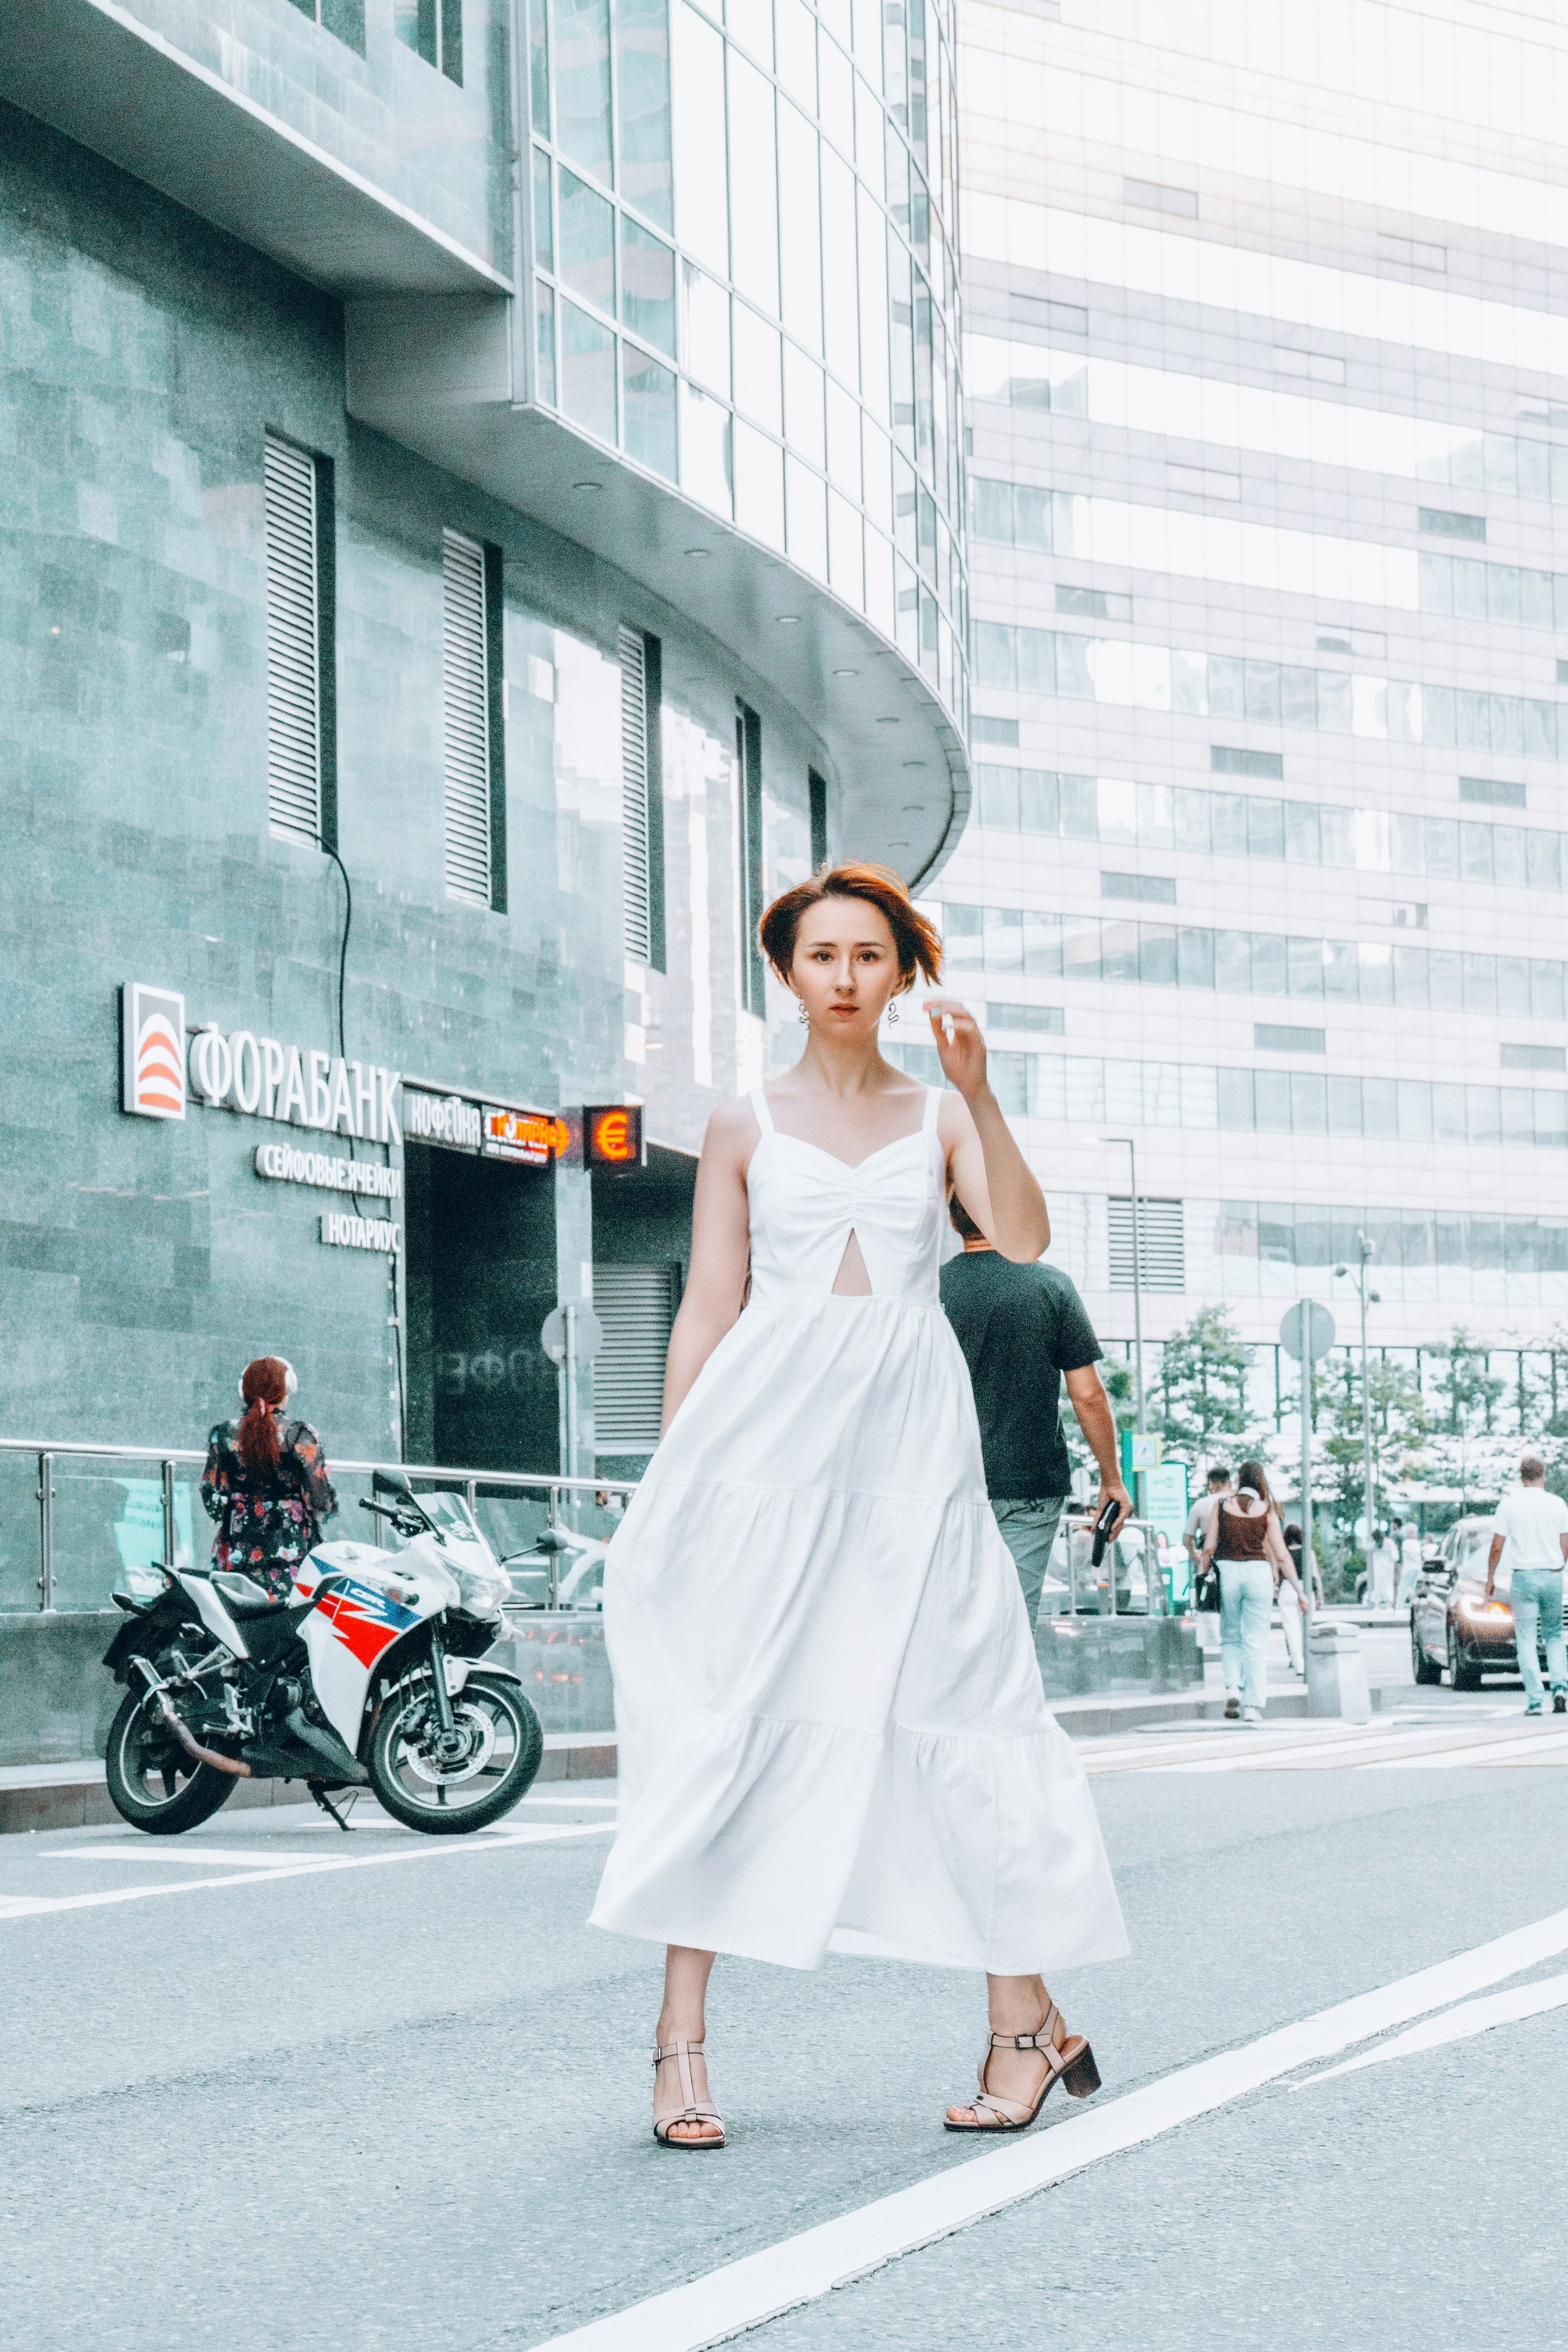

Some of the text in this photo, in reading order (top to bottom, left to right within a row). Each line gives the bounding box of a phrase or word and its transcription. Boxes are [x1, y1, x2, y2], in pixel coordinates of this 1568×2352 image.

[192, 1022, 402, 1145] ФОРАБАНК
[412, 1093, 481, 1147] КОФЕЙНЯ
[263, 1142, 402, 1197] СЕЙФОВЫЕ ЯЧЕЙКИ
[328, 1212, 402, 1253] НОТАРИУС
